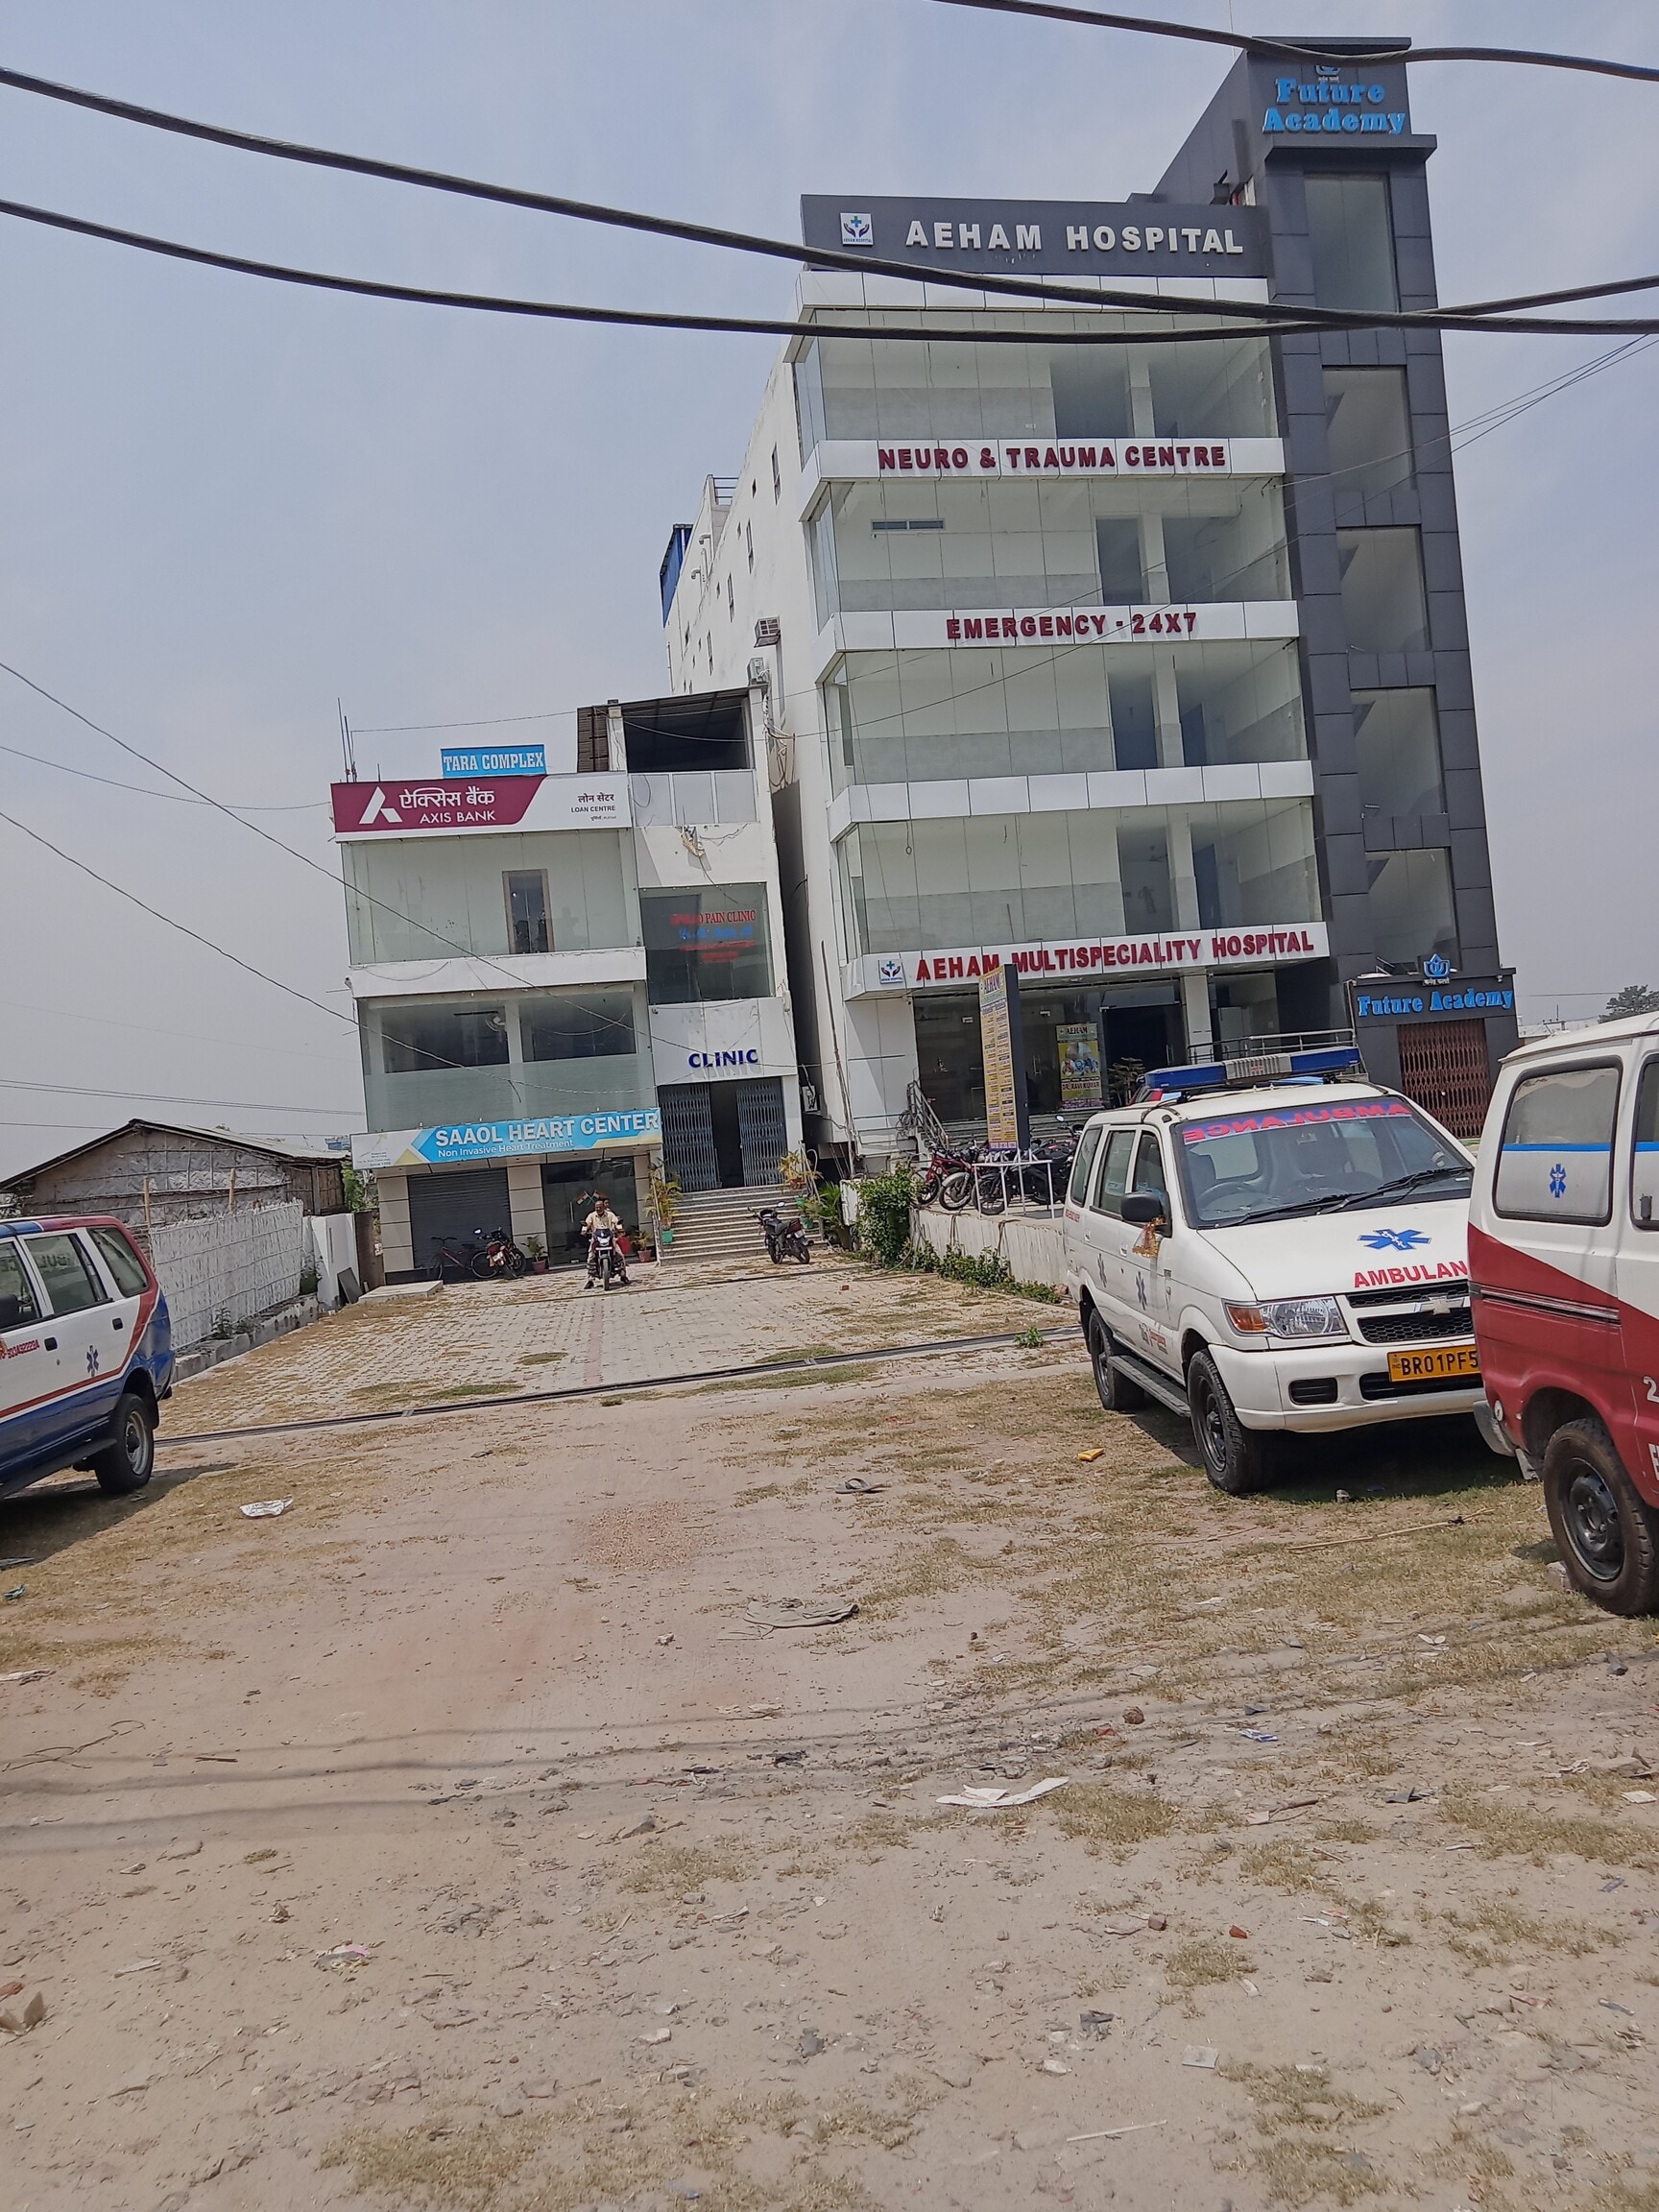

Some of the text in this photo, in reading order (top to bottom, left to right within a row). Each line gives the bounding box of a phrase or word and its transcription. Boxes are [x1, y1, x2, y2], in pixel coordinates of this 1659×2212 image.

[1275, 77, 1385, 105] Future
[1262, 107, 1406, 134] Academy
[905, 220, 1243, 253] AEHAM HOSPITAL
[878, 445, 1226, 469] NEURO & TRAUMA CENTRE
[946, 614, 1106, 639] EMERGENCY
[1131, 612, 1197, 634] 24X7
[443, 752, 545, 772] TARA COMPLEX
[420, 810, 496, 825] AXIS BANK
[706, 912, 725, 924] PAIN
[727, 910, 757, 923] CLINIC
[916, 930, 1314, 981] AEHAM MULTISPECIALITY HOSPITAL
[1357, 988, 1514, 1017] Future Academy
[688, 1048, 758, 1069] CLINIC
[435, 1113, 659, 1147] SAAOL HEART CENTER
[438, 1139, 574, 1158] Non Invasive Heart Treatment
